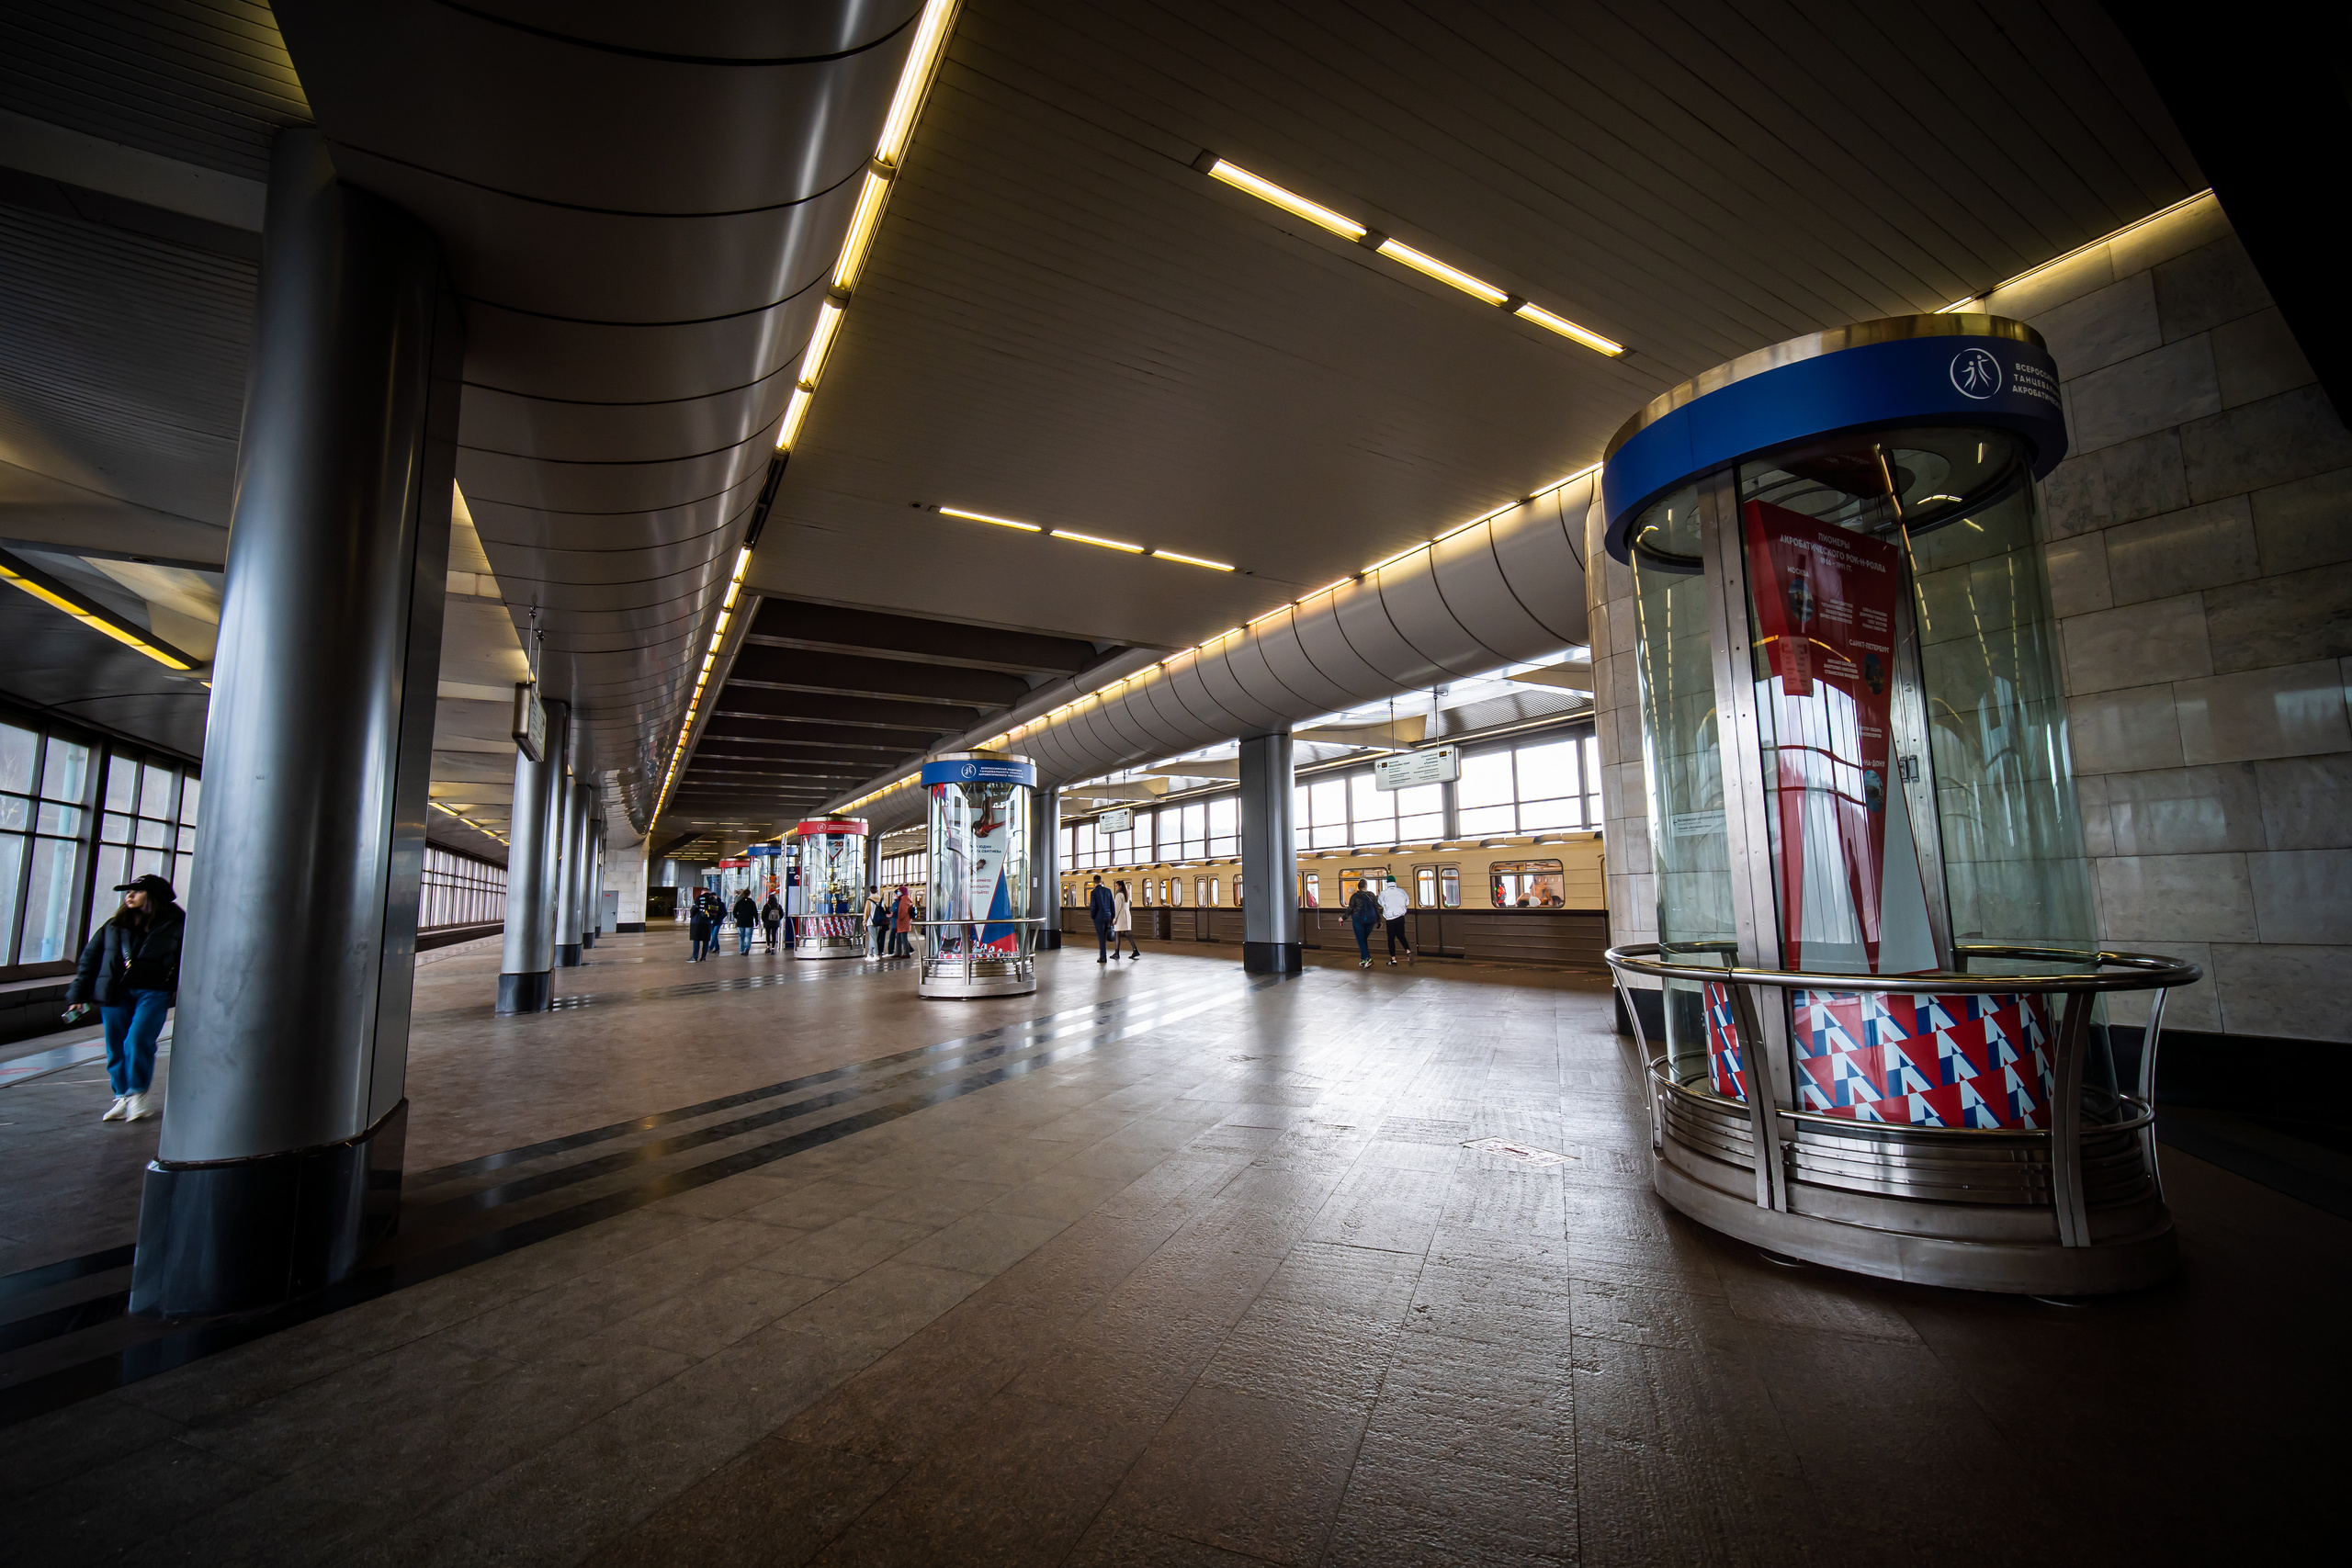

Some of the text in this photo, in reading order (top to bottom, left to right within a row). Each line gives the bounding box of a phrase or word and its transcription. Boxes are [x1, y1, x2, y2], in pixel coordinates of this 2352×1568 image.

[1780, 534, 1845, 560] АКРОБАТИЧЕСКОГО
[1818, 532, 1850, 550] ПИОНЕРЫ
[1787, 566, 1810, 578] МОСКВА
[1849, 638, 1890, 653] САНКТ-ПЕТЕРБУРГ
